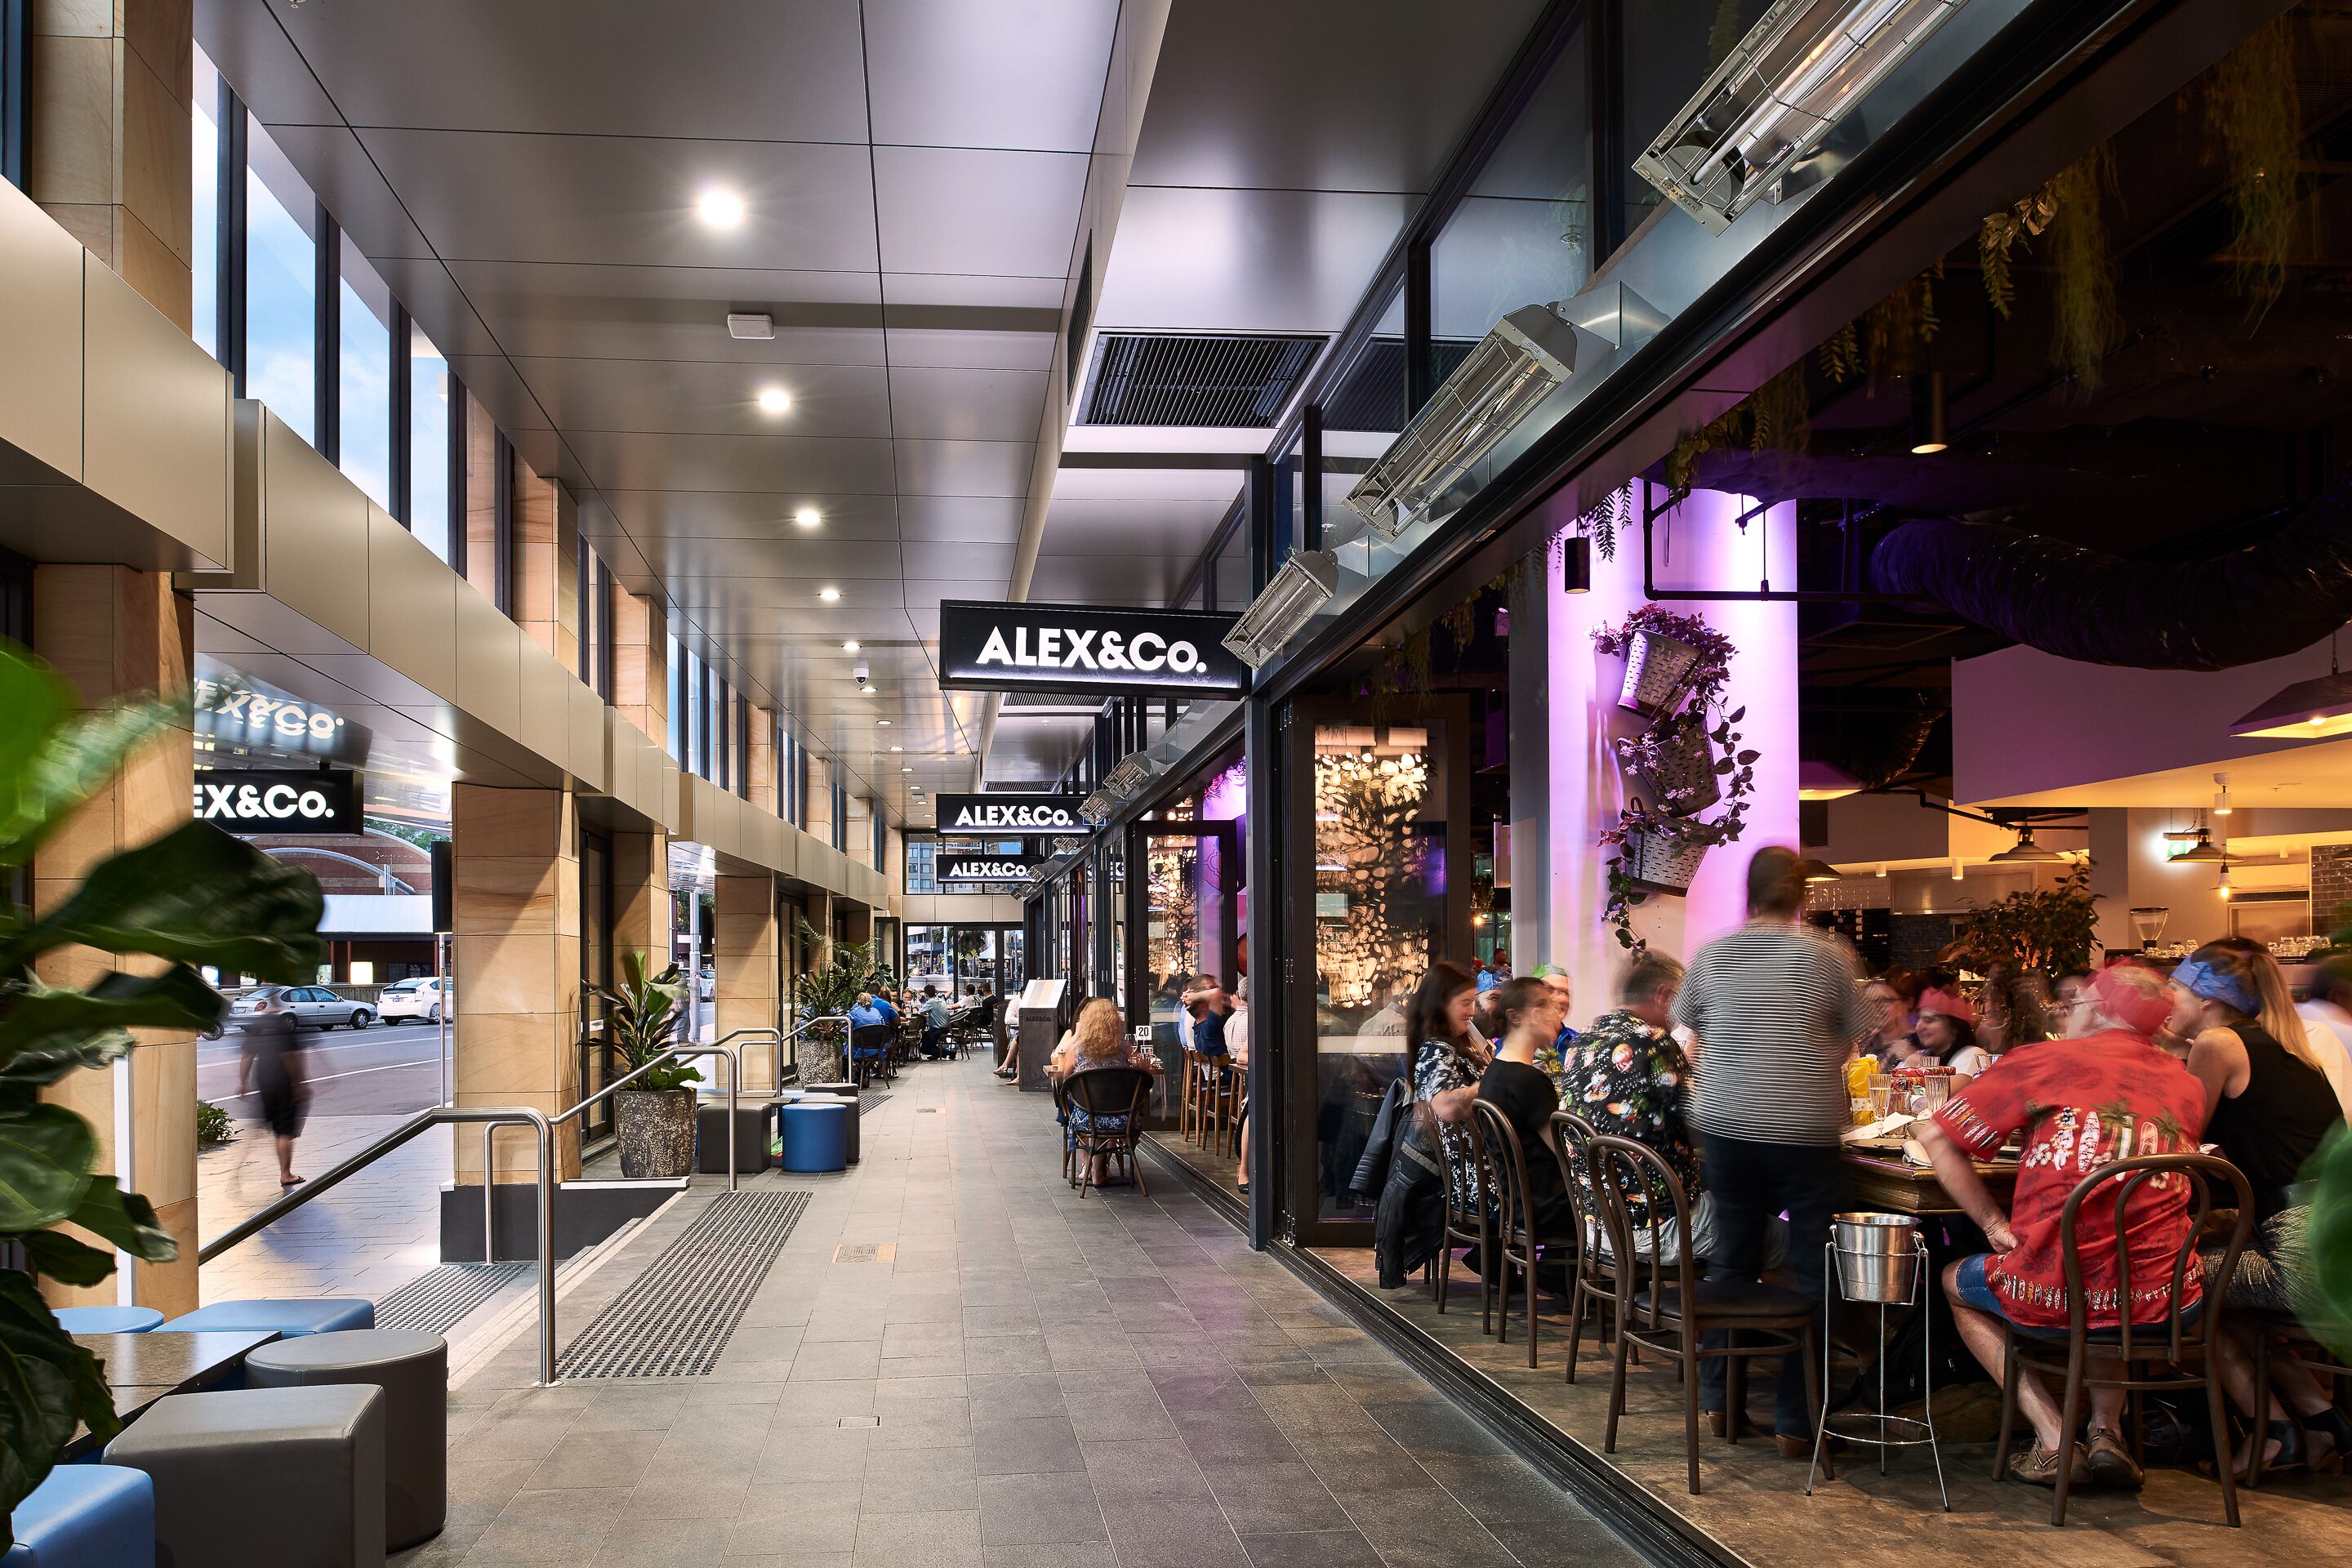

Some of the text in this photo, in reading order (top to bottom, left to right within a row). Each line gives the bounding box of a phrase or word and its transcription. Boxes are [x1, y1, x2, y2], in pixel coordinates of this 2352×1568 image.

[975, 626, 1207, 673] ALEX&Co.
[955, 805, 1074, 826] ALEX&Co.
[1138, 1027, 1149, 1037] 20
